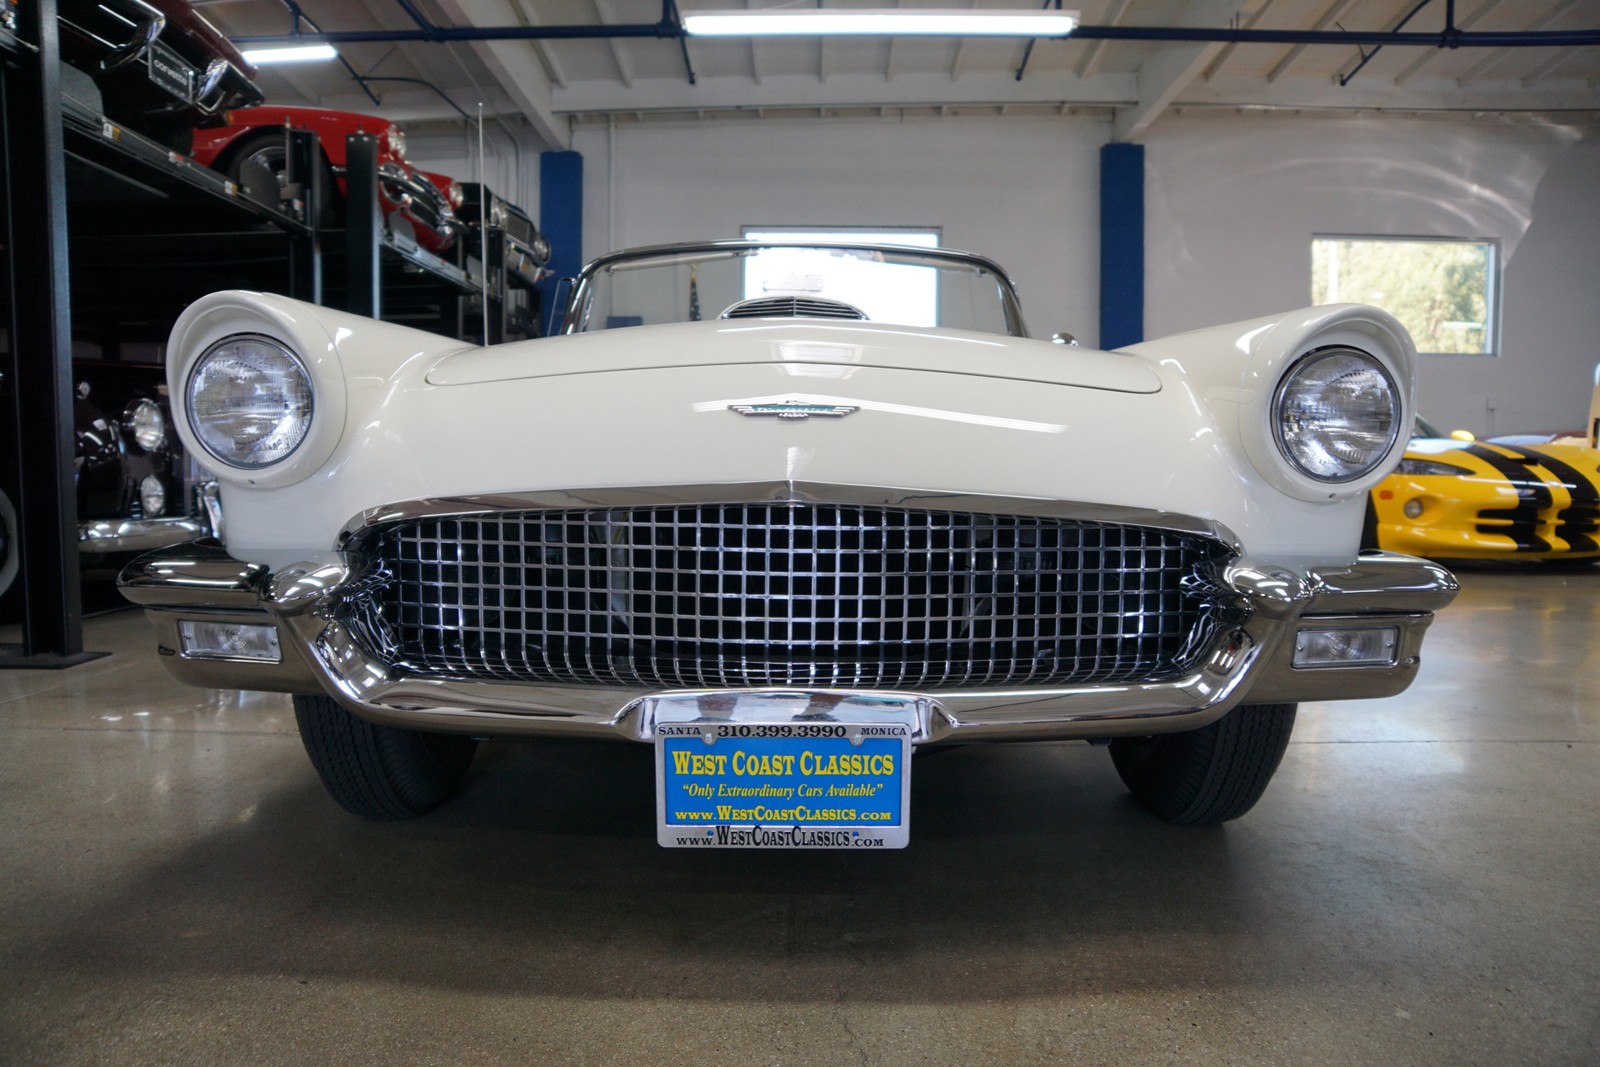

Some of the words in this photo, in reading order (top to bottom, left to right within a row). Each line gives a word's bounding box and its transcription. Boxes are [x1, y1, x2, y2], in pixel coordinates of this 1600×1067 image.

[658, 726, 702, 736] SANTA
[717, 725, 847, 738] 310.399.3990
[860, 727, 907, 736] MONICA
[672, 750, 728, 776] WEST
[732, 750, 796, 776] COAST
[799, 750, 895, 776] CLASSICS
[682, 783, 715, 800] “Only
[717, 783, 795, 801] Extraordinary
[797, 783, 824, 797] Cars
[825, 783, 884, 797] Available”
